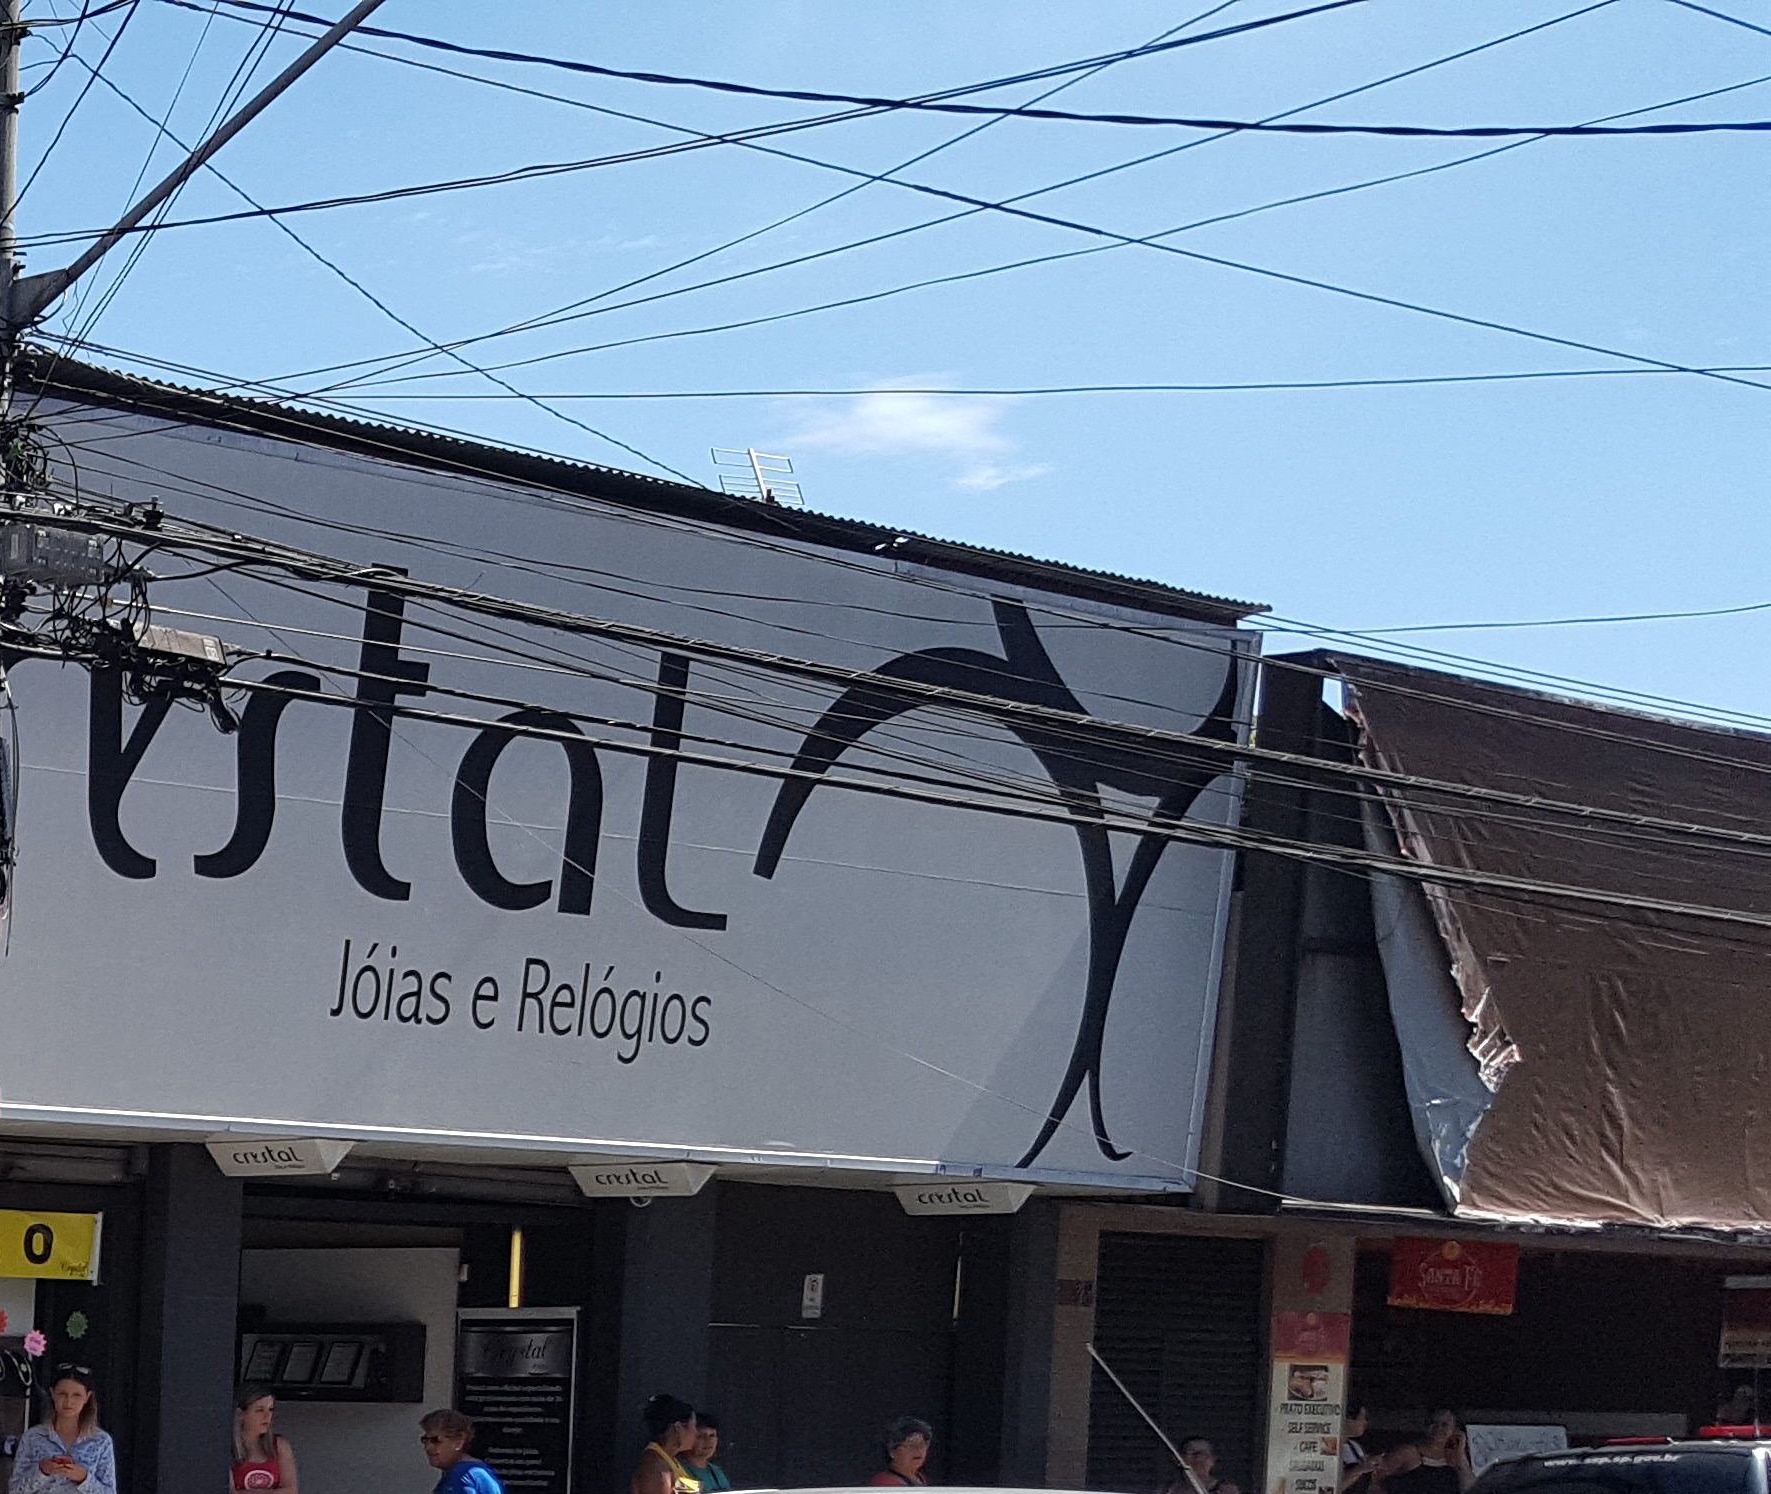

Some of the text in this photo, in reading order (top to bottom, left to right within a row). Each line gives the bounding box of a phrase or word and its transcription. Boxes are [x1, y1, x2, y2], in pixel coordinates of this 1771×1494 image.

[329, 938, 714, 1065] Jóias e Relógios
